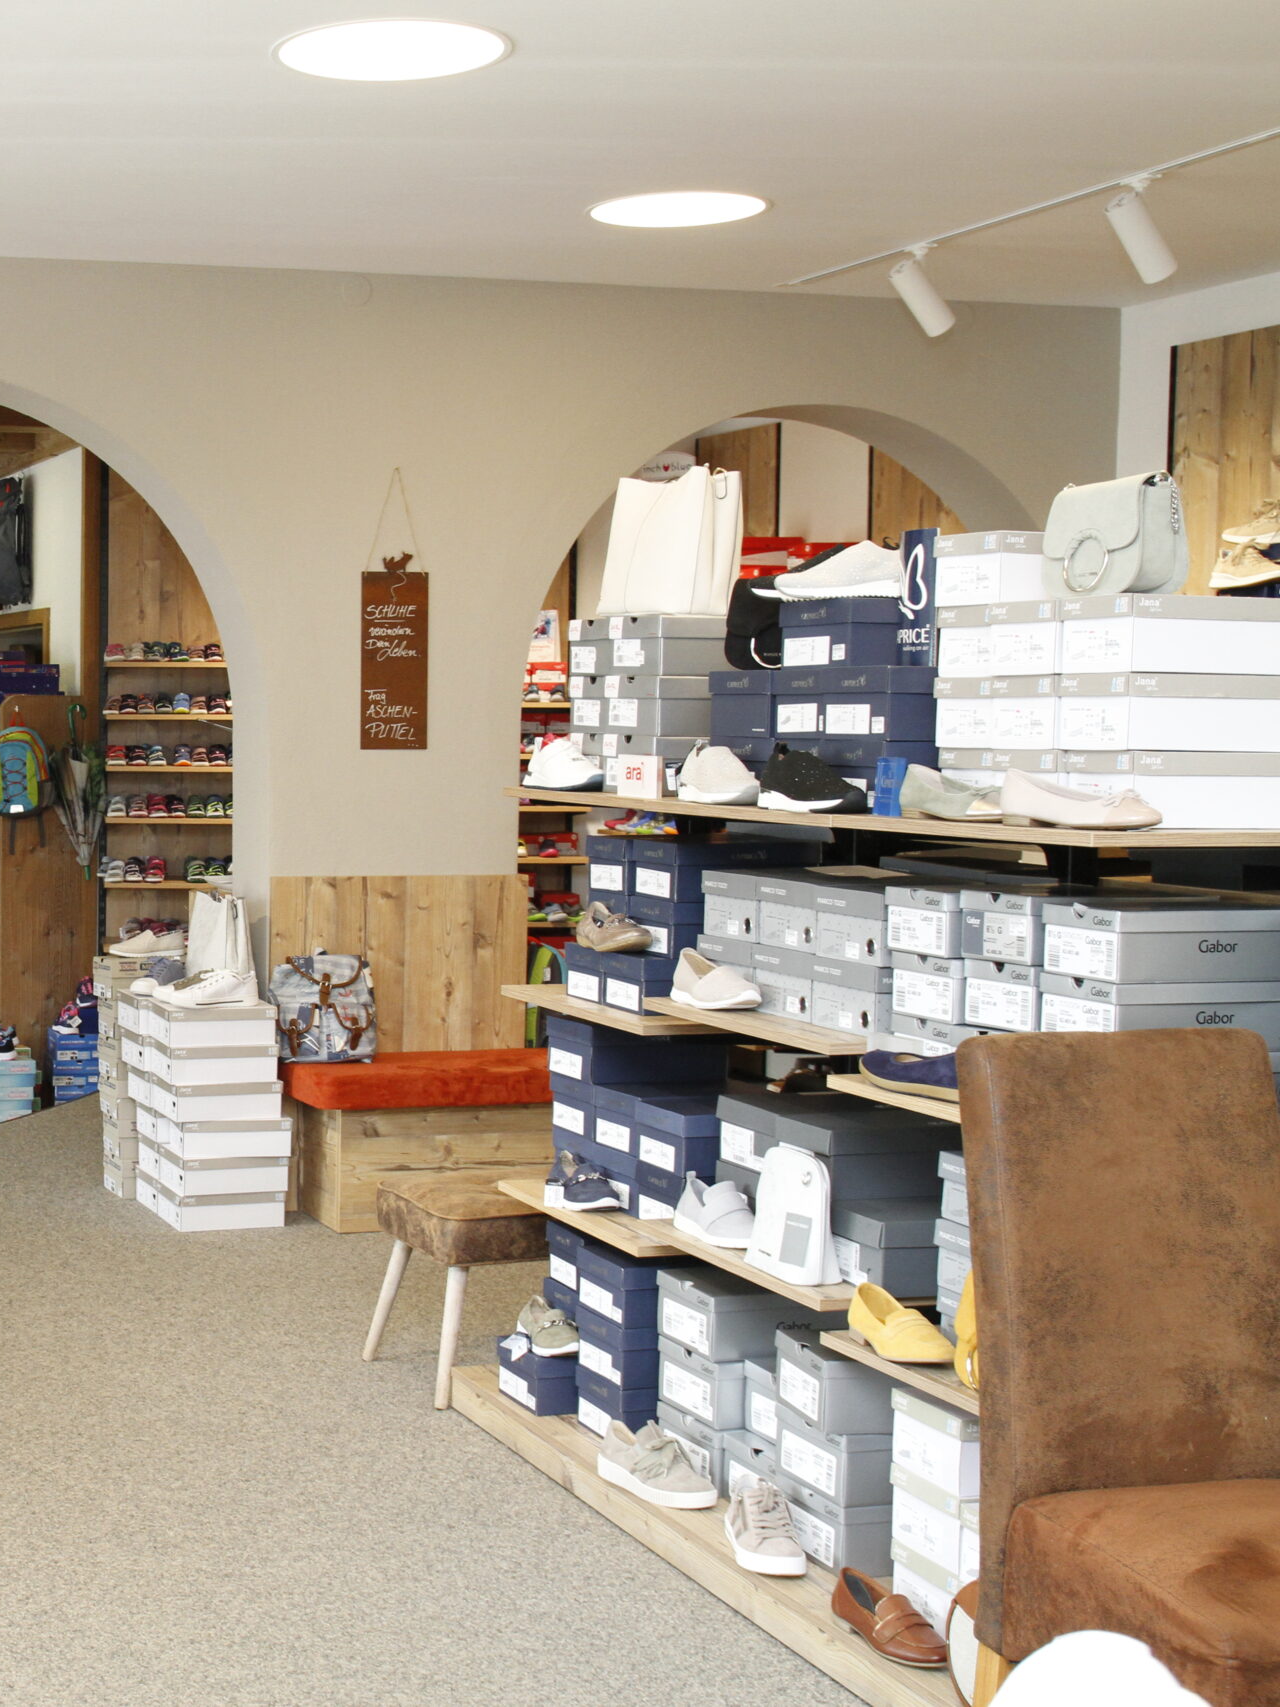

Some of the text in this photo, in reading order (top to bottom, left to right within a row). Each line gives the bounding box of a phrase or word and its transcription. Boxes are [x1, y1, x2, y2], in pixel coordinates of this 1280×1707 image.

[1139, 598, 1160, 606] Jana
[364, 604, 416, 620] SCHUHE
[1135, 677, 1157, 685] Jana
[1140, 756, 1162, 764] Jana
[625, 766, 642, 781] ara
[924, 896, 941, 907] Gabor
[1005, 900, 1024, 911] Gabor
[1092, 915, 1112, 927] Gabor
[1198, 939, 1238, 954] Gabor
[933, 962, 950, 974] Gabor
[1010, 970, 1030, 982] Gabor
[1090, 986, 1110, 998] Gabor
[1195, 1010, 1236, 1026] Gabor
[932, 1027, 948, 1039] Gabor
